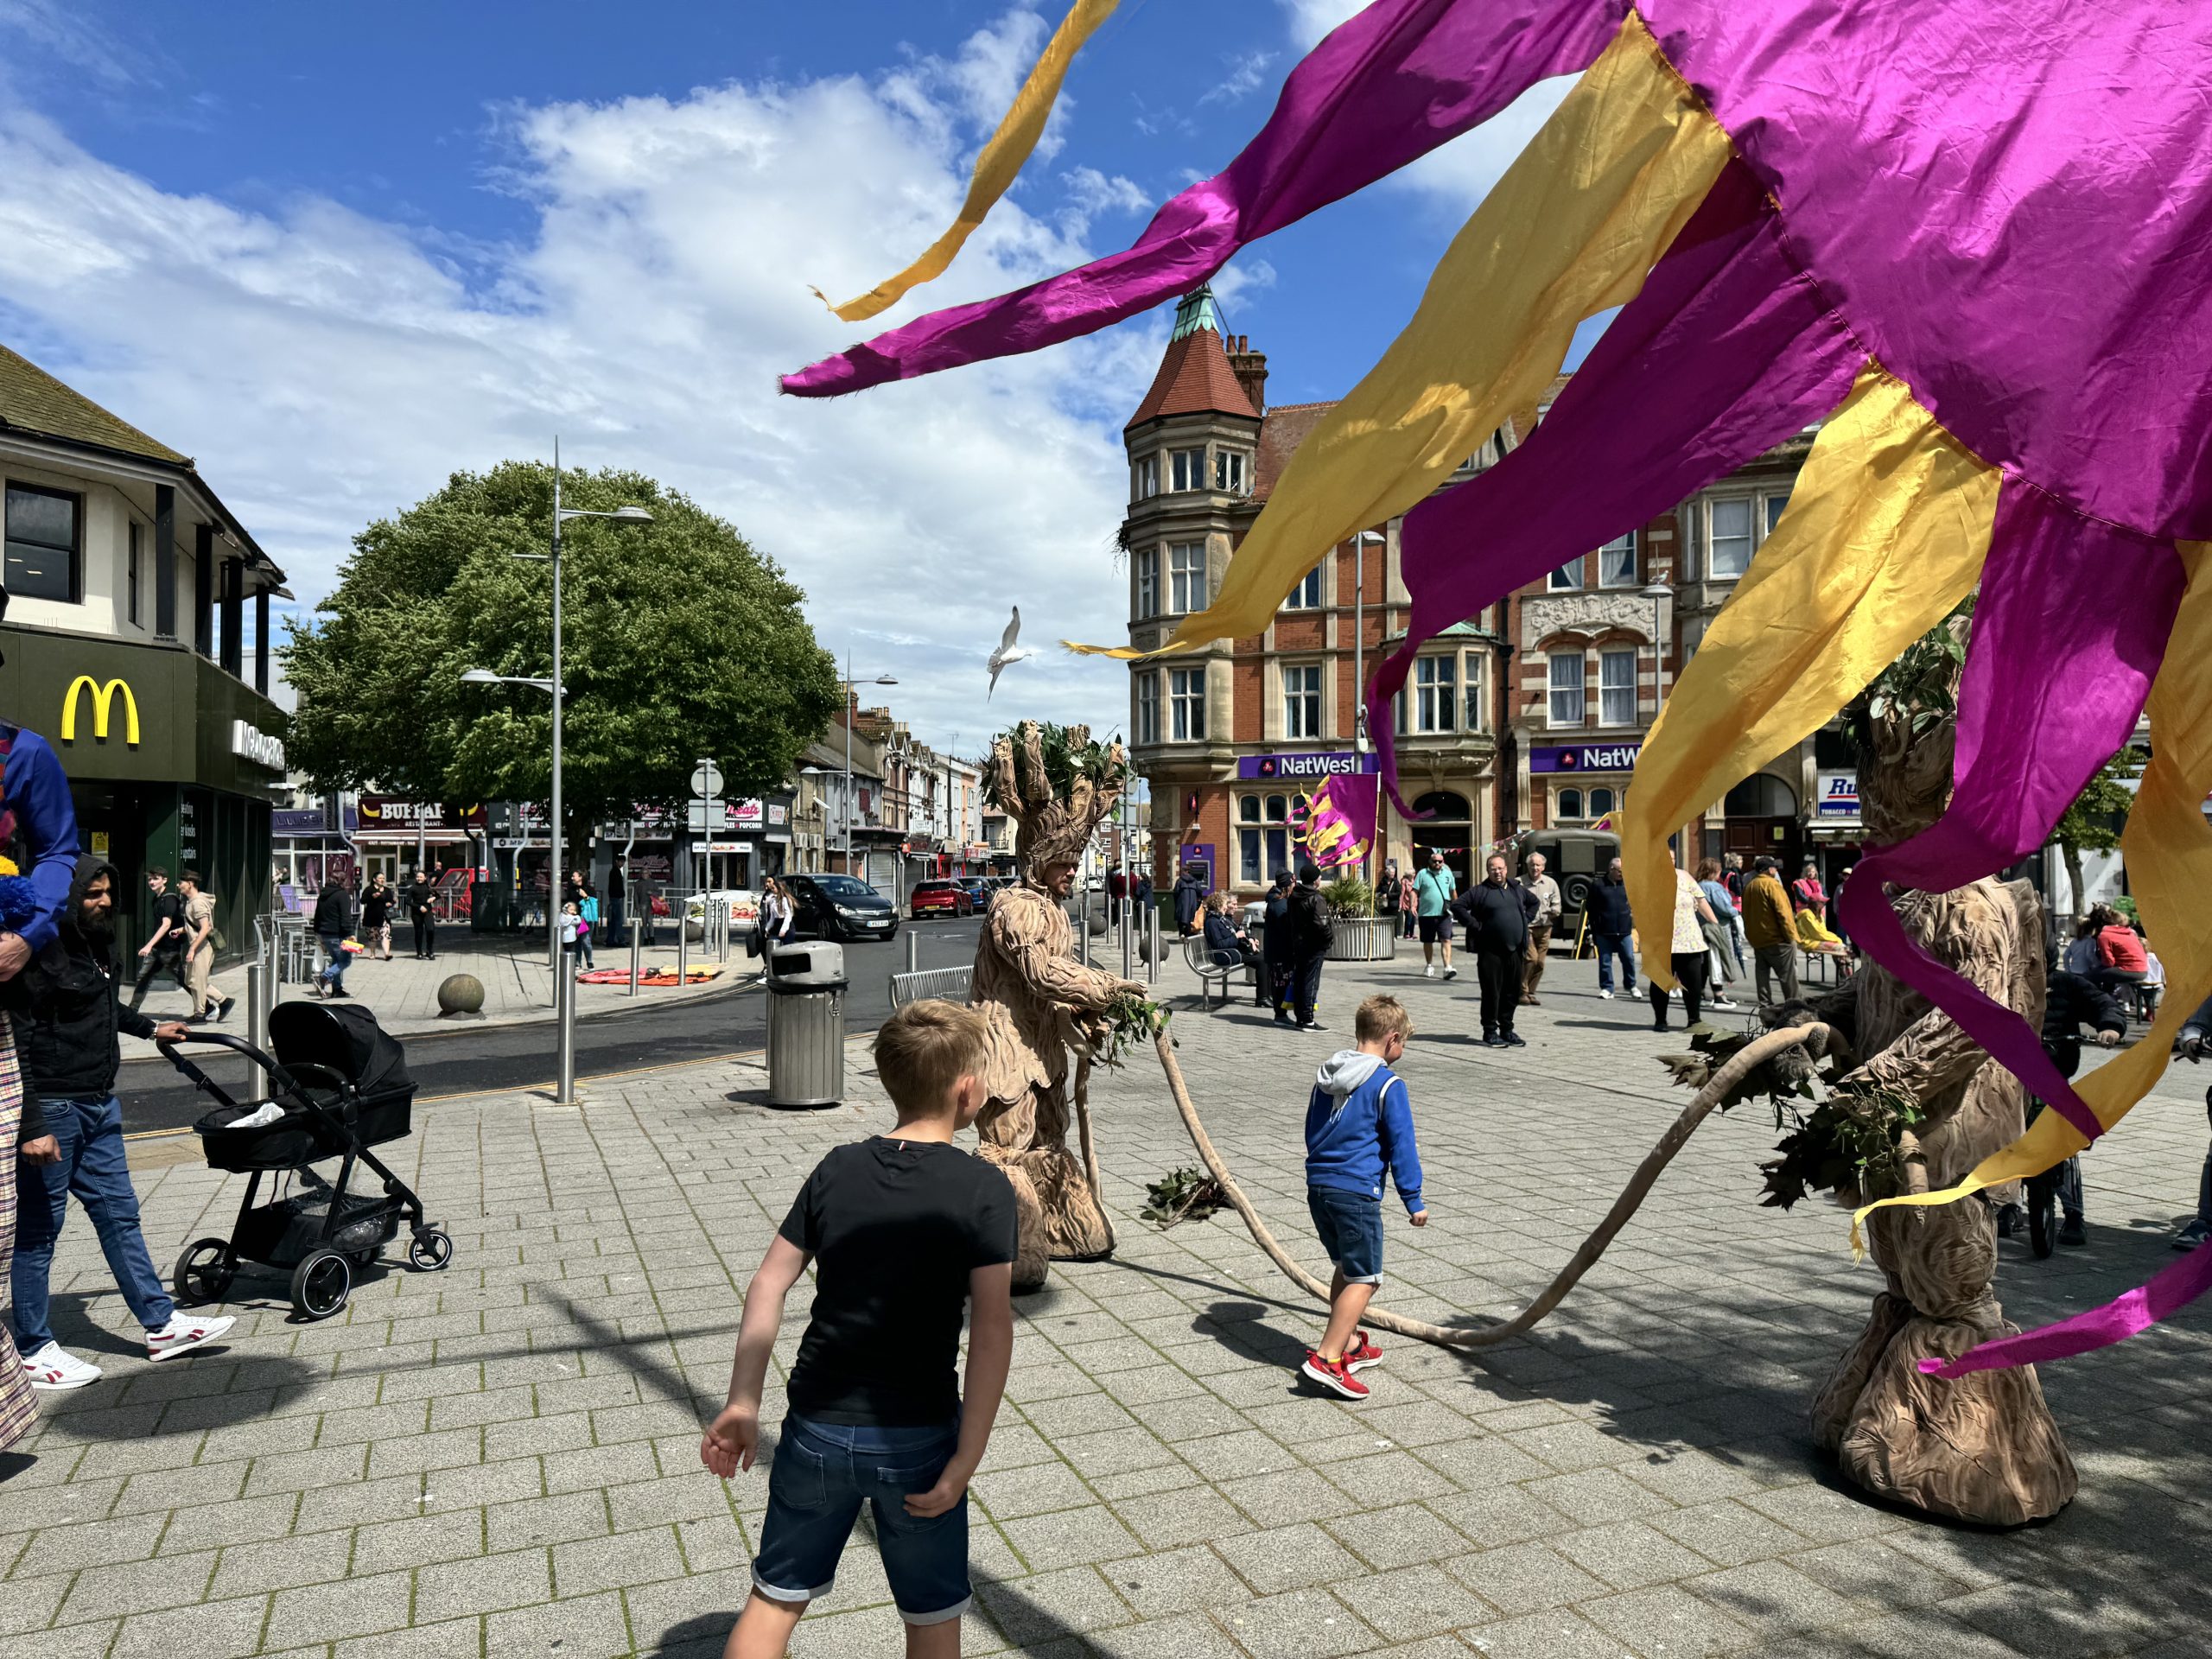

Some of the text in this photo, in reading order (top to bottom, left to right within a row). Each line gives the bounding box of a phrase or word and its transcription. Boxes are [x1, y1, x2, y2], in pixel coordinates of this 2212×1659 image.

[1281, 755, 1355, 775] NatWest
[1584, 747, 1642, 767] NatW
[1828, 779, 1858, 795] Ru
[380, 802, 445, 819] BUFFAL
